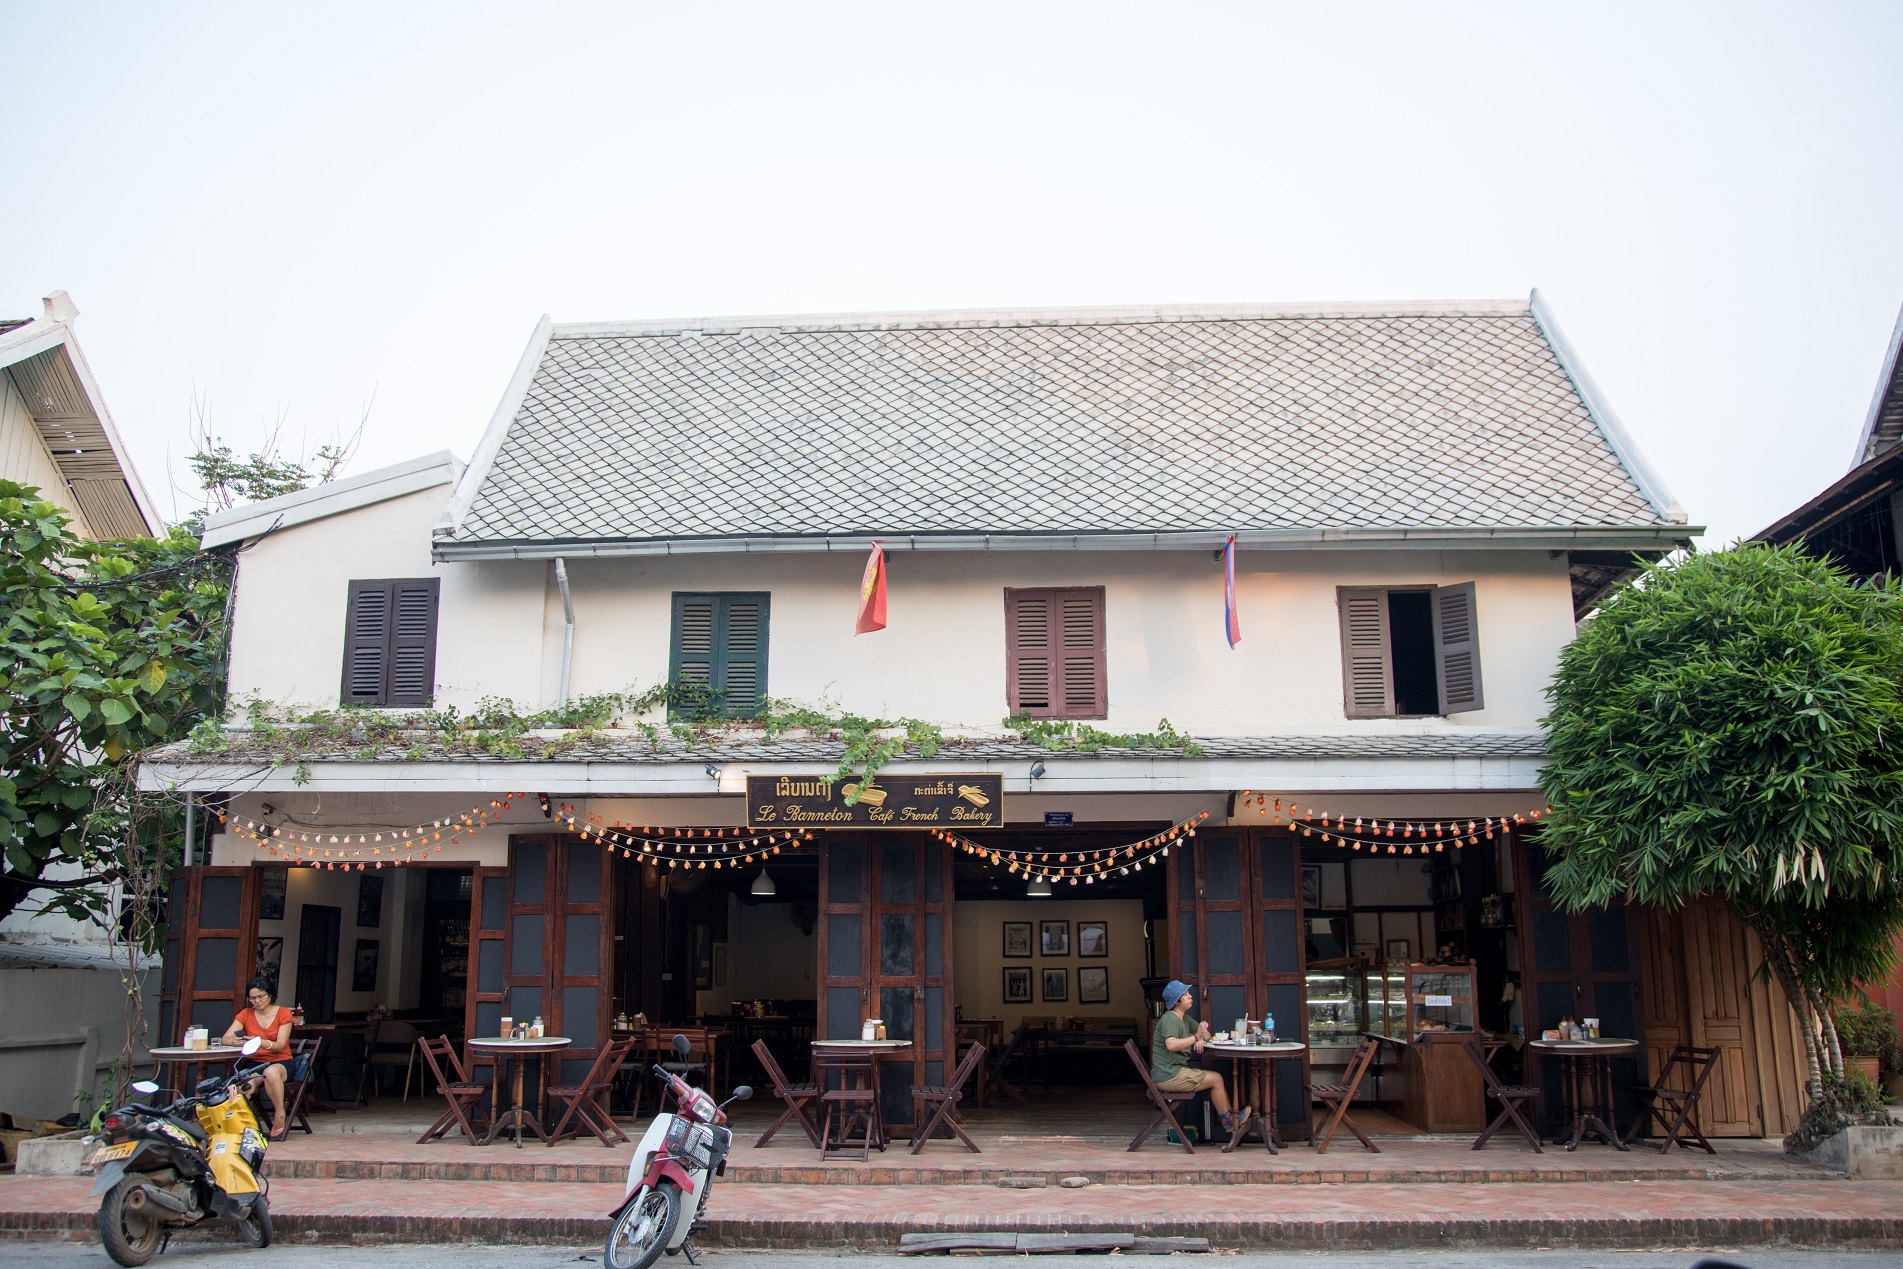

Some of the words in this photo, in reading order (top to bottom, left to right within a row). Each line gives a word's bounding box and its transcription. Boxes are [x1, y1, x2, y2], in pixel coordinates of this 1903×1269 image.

[755, 805, 777, 822] Le
[783, 805, 853, 821] Banneton
[868, 806, 895, 824] Café
[900, 806, 939, 821] French
[949, 806, 993, 826] Bakery
